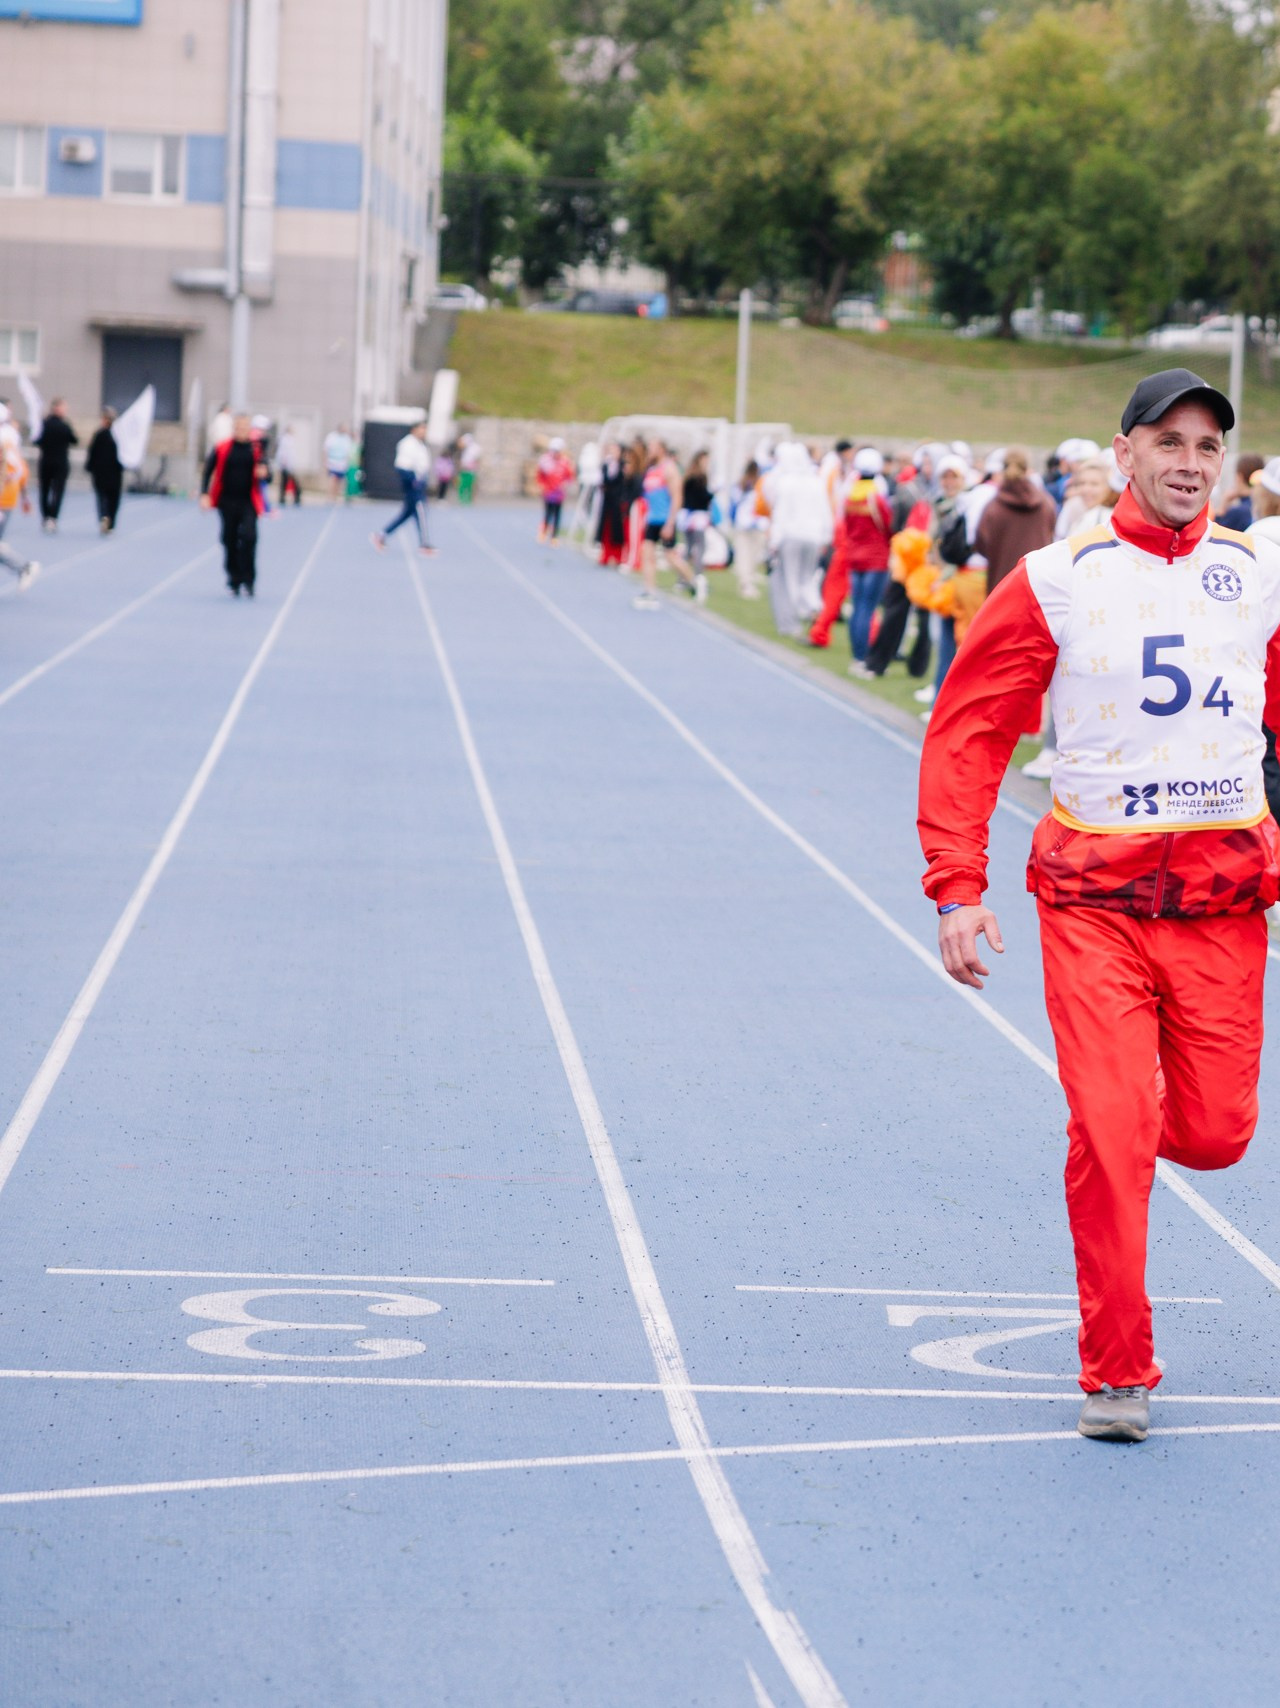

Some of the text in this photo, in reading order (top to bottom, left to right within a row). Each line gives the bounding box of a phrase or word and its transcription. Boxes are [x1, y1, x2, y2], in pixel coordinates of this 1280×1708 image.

[1139, 633, 1234, 717] 5 4
[1166, 777, 1244, 797] КОМОС
[1166, 796, 1244, 808] МЕНДЕЛЕЕВСКАЯ
[1166, 807, 1244, 816] ПТИЦЕФАБРИКА
[180, 1288, 442, 1362] 3
[886, 1304, 1167, 1380] 2
